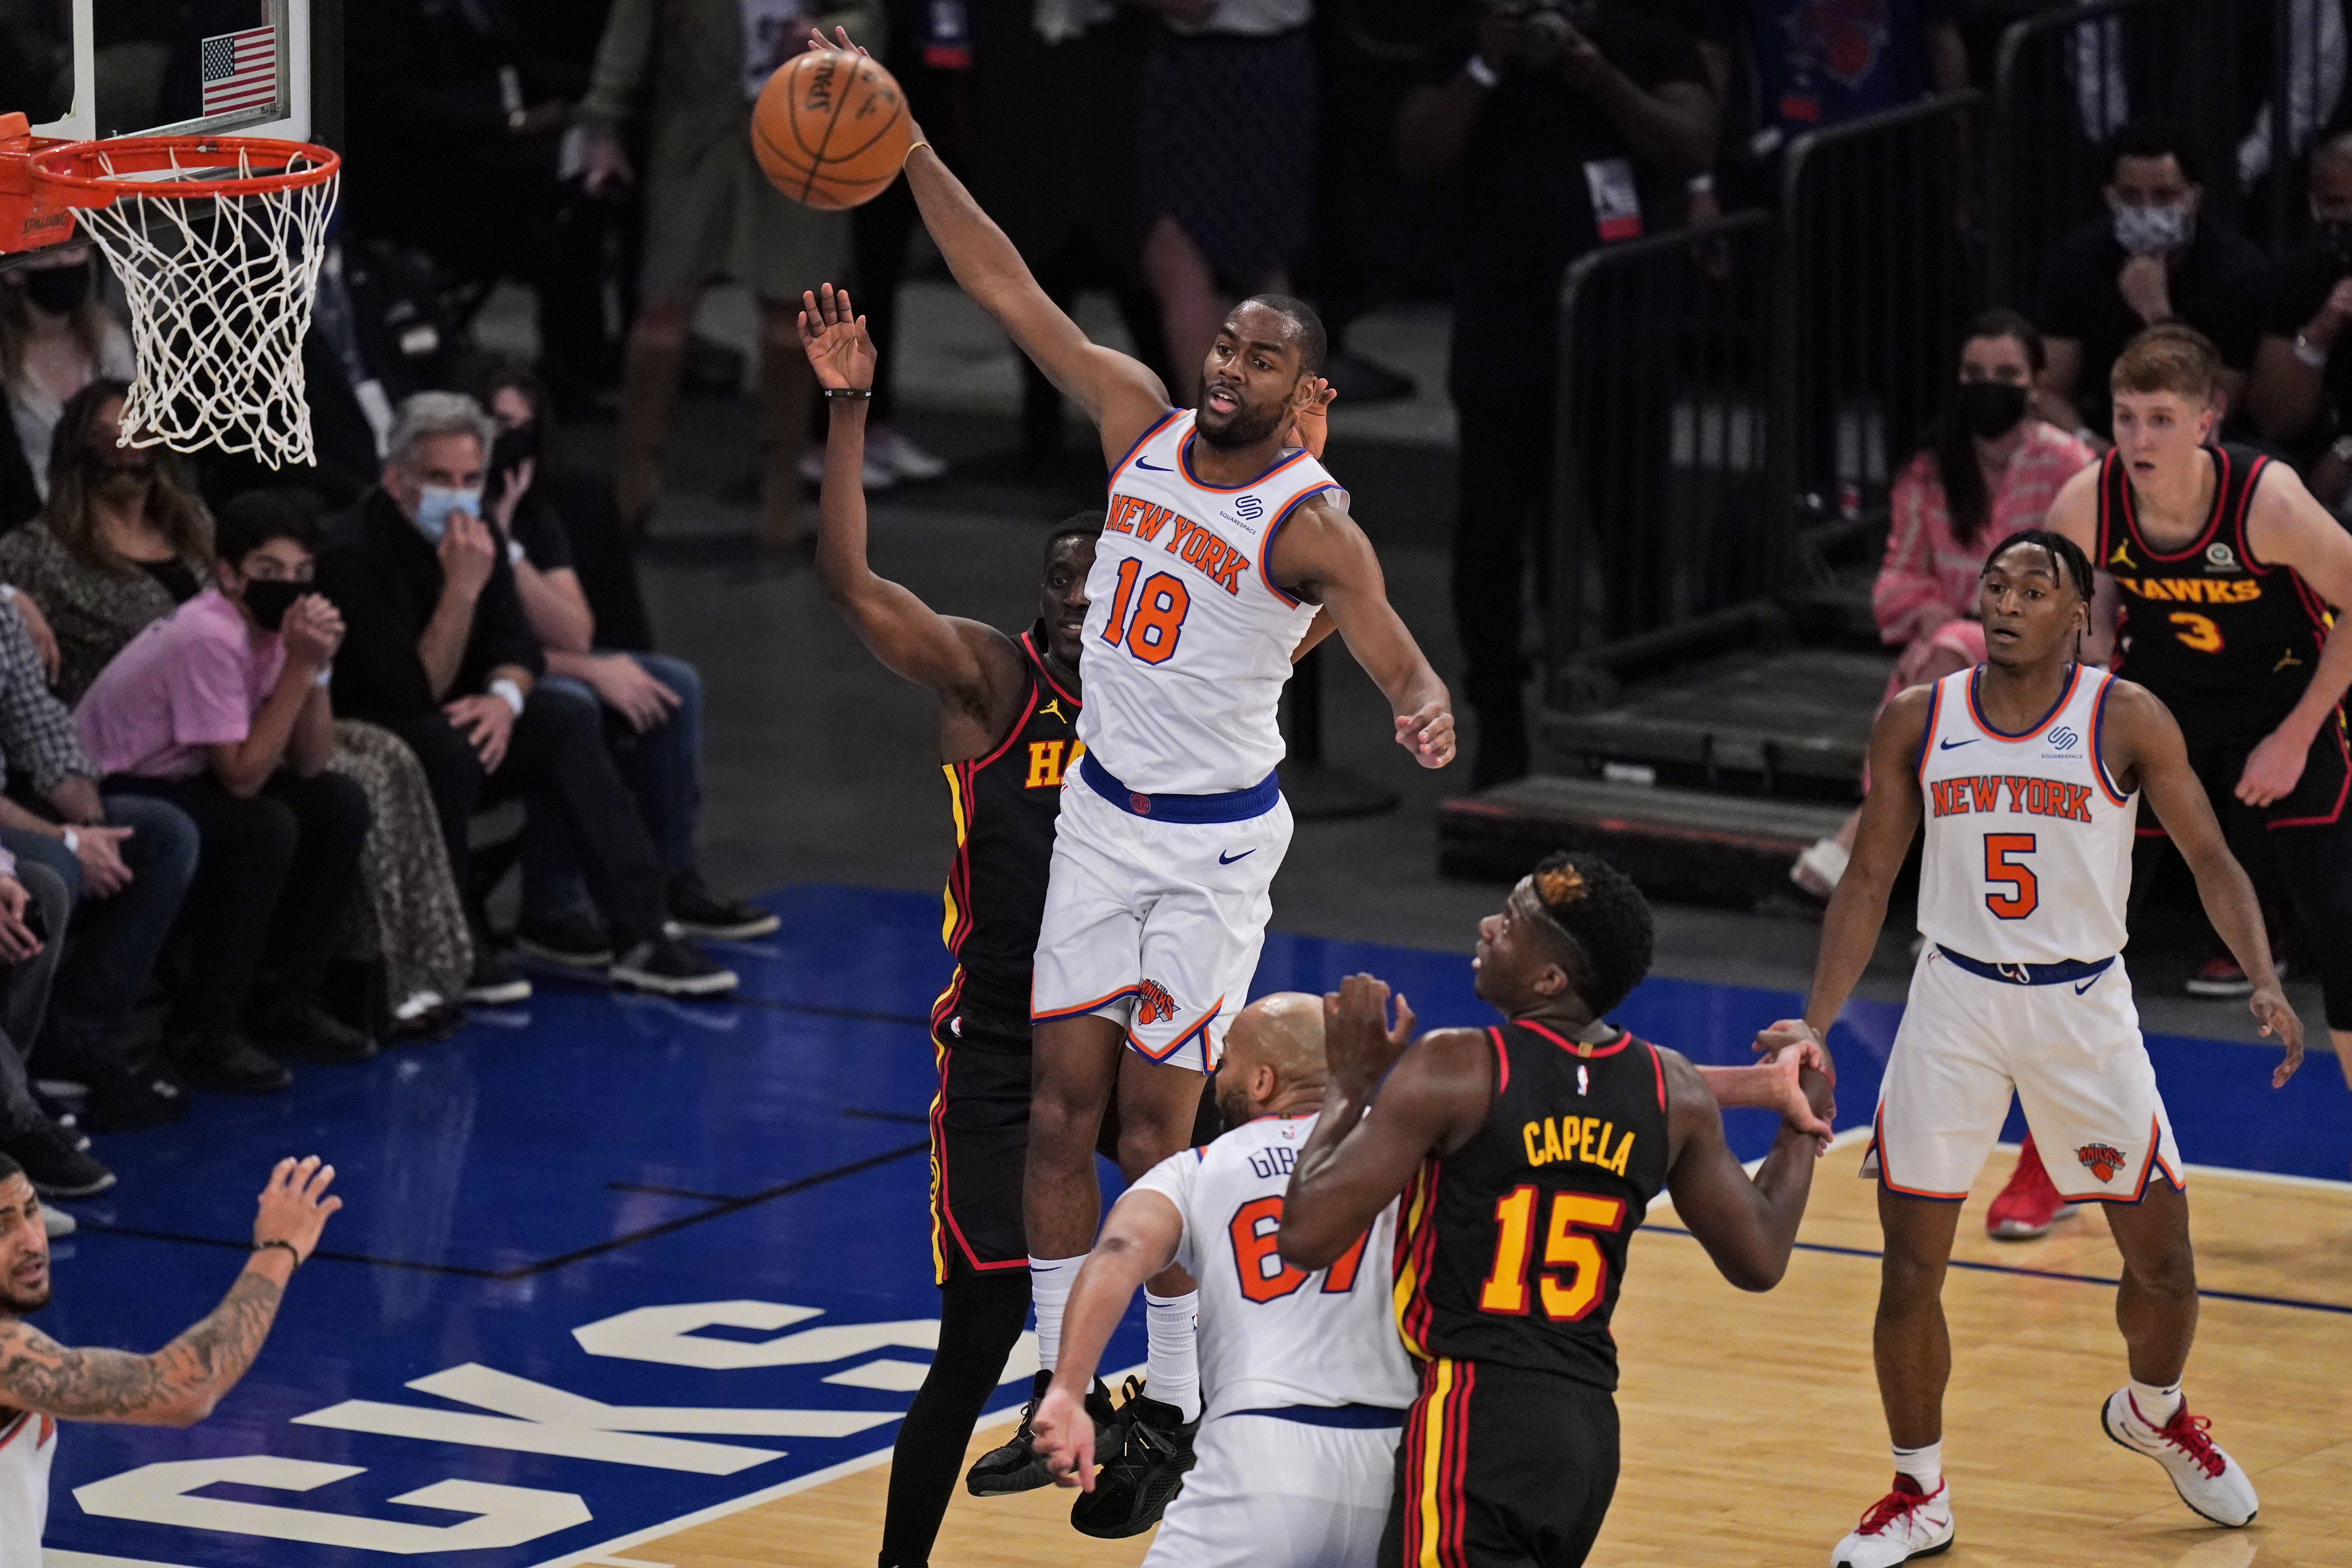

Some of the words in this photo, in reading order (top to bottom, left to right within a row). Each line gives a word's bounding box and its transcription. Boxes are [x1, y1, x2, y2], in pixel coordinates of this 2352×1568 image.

[1105, 494, 1174, 541] NEW
[1165, 514, 1251, 597] YORK
[1219, 511, 1257, 535] SQUARESPACE
[1100, 556, 1191, 665] 18
[2168, 611, 2225, 654] 3
[1930, 775, 2002, 818] NEW
[2004, 775, 2092, 823] YORK
[1983, 833, 2038, 920] 5
[1140, 978, 1174, 1020] KNICKS
[1247, 1147, 1300, 1178] GIB
[1522, 1115, 1636, 1177] CAPELA
[2079, 1146, 2126, 1166] KNICKS
[1478, 1183, 1626, 1322] 15
